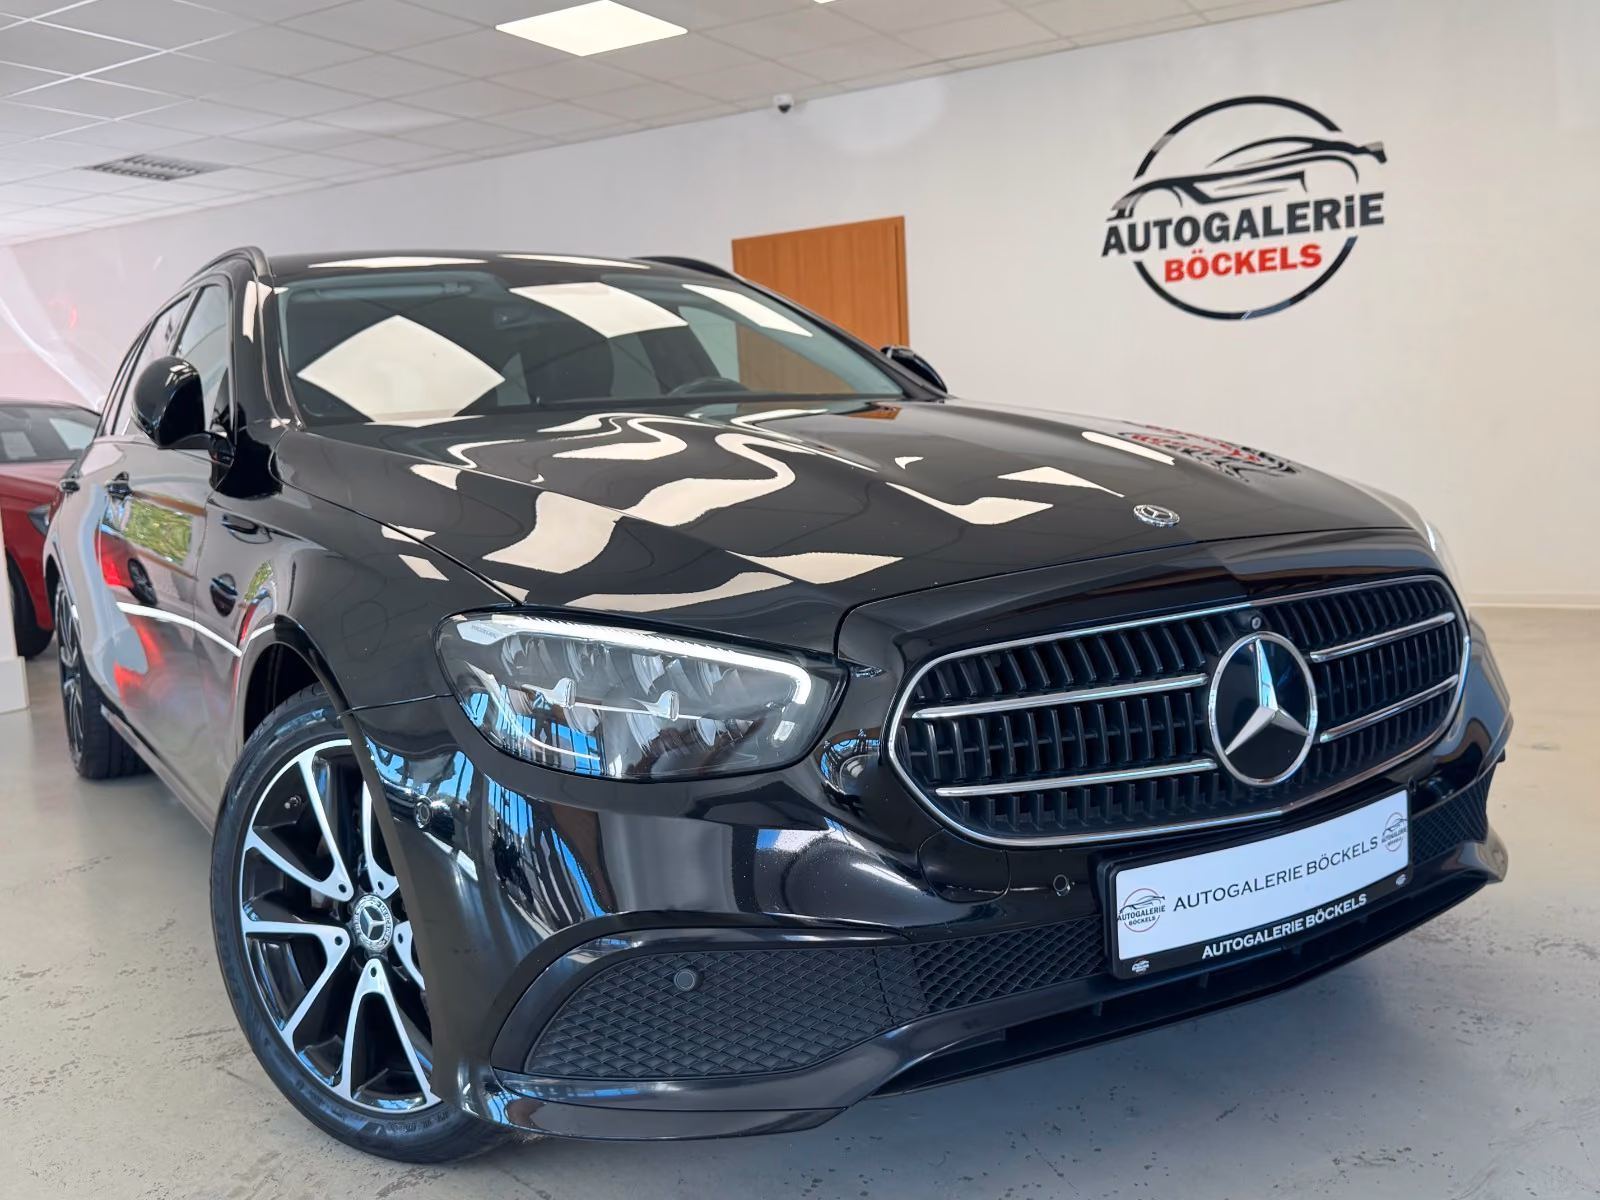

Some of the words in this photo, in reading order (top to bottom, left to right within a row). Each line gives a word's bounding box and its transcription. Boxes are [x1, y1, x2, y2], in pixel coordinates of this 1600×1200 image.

[1165, 244, 1322, 283] BÖCKELS
[1173, 865, 1304, 912] AUTOGALERIE
[1306, 836, 1378, 876] BÖCKELS
[1202, 919, 1304, 959] AUTOGALERIE
[1305, 893, 1368, 929] BÖCKELS
